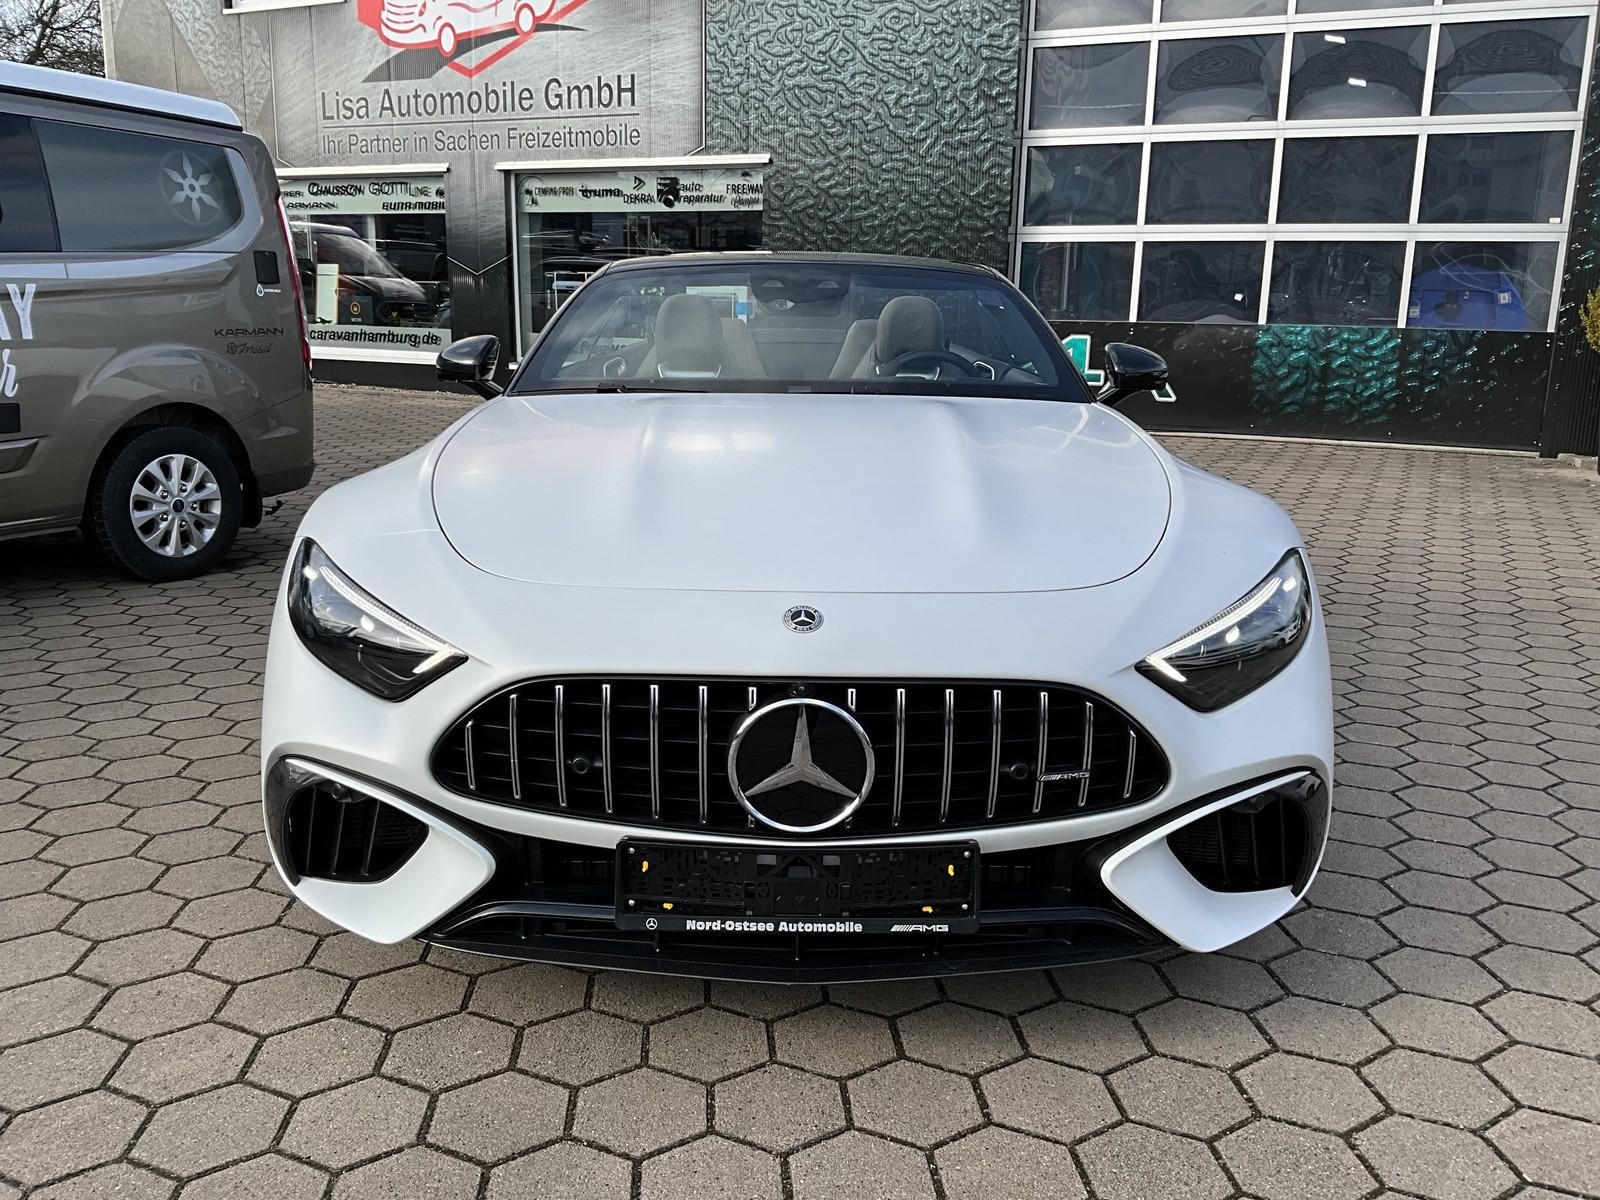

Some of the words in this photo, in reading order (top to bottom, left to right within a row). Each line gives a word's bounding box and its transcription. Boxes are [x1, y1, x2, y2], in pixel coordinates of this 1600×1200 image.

[321, 91, 369, 120] Lisa
[379, 81, 534, 118] Automobile
[544, 74, 636, 110] GmbH
[322, 134, 343, 154] Ihr
[348, 133, 408, 153] Partner
[413, 131, 428, 152] in
[434, 128, 500, 151] Sachen
[507, 123, 641, 149] Freizeitmobile
[679, 182, 704, 193] auto
[623, 193, 655, 204] DEKRA
[679, 194, 726, 206] reparatur
[214, 328, 284, 337] KARMANN
[309, 329, 442, 347] caravanhamburg.de
[686, 919, 775, 931] Nord-Ostsee
[778, 921, 863, 932] Automobile
